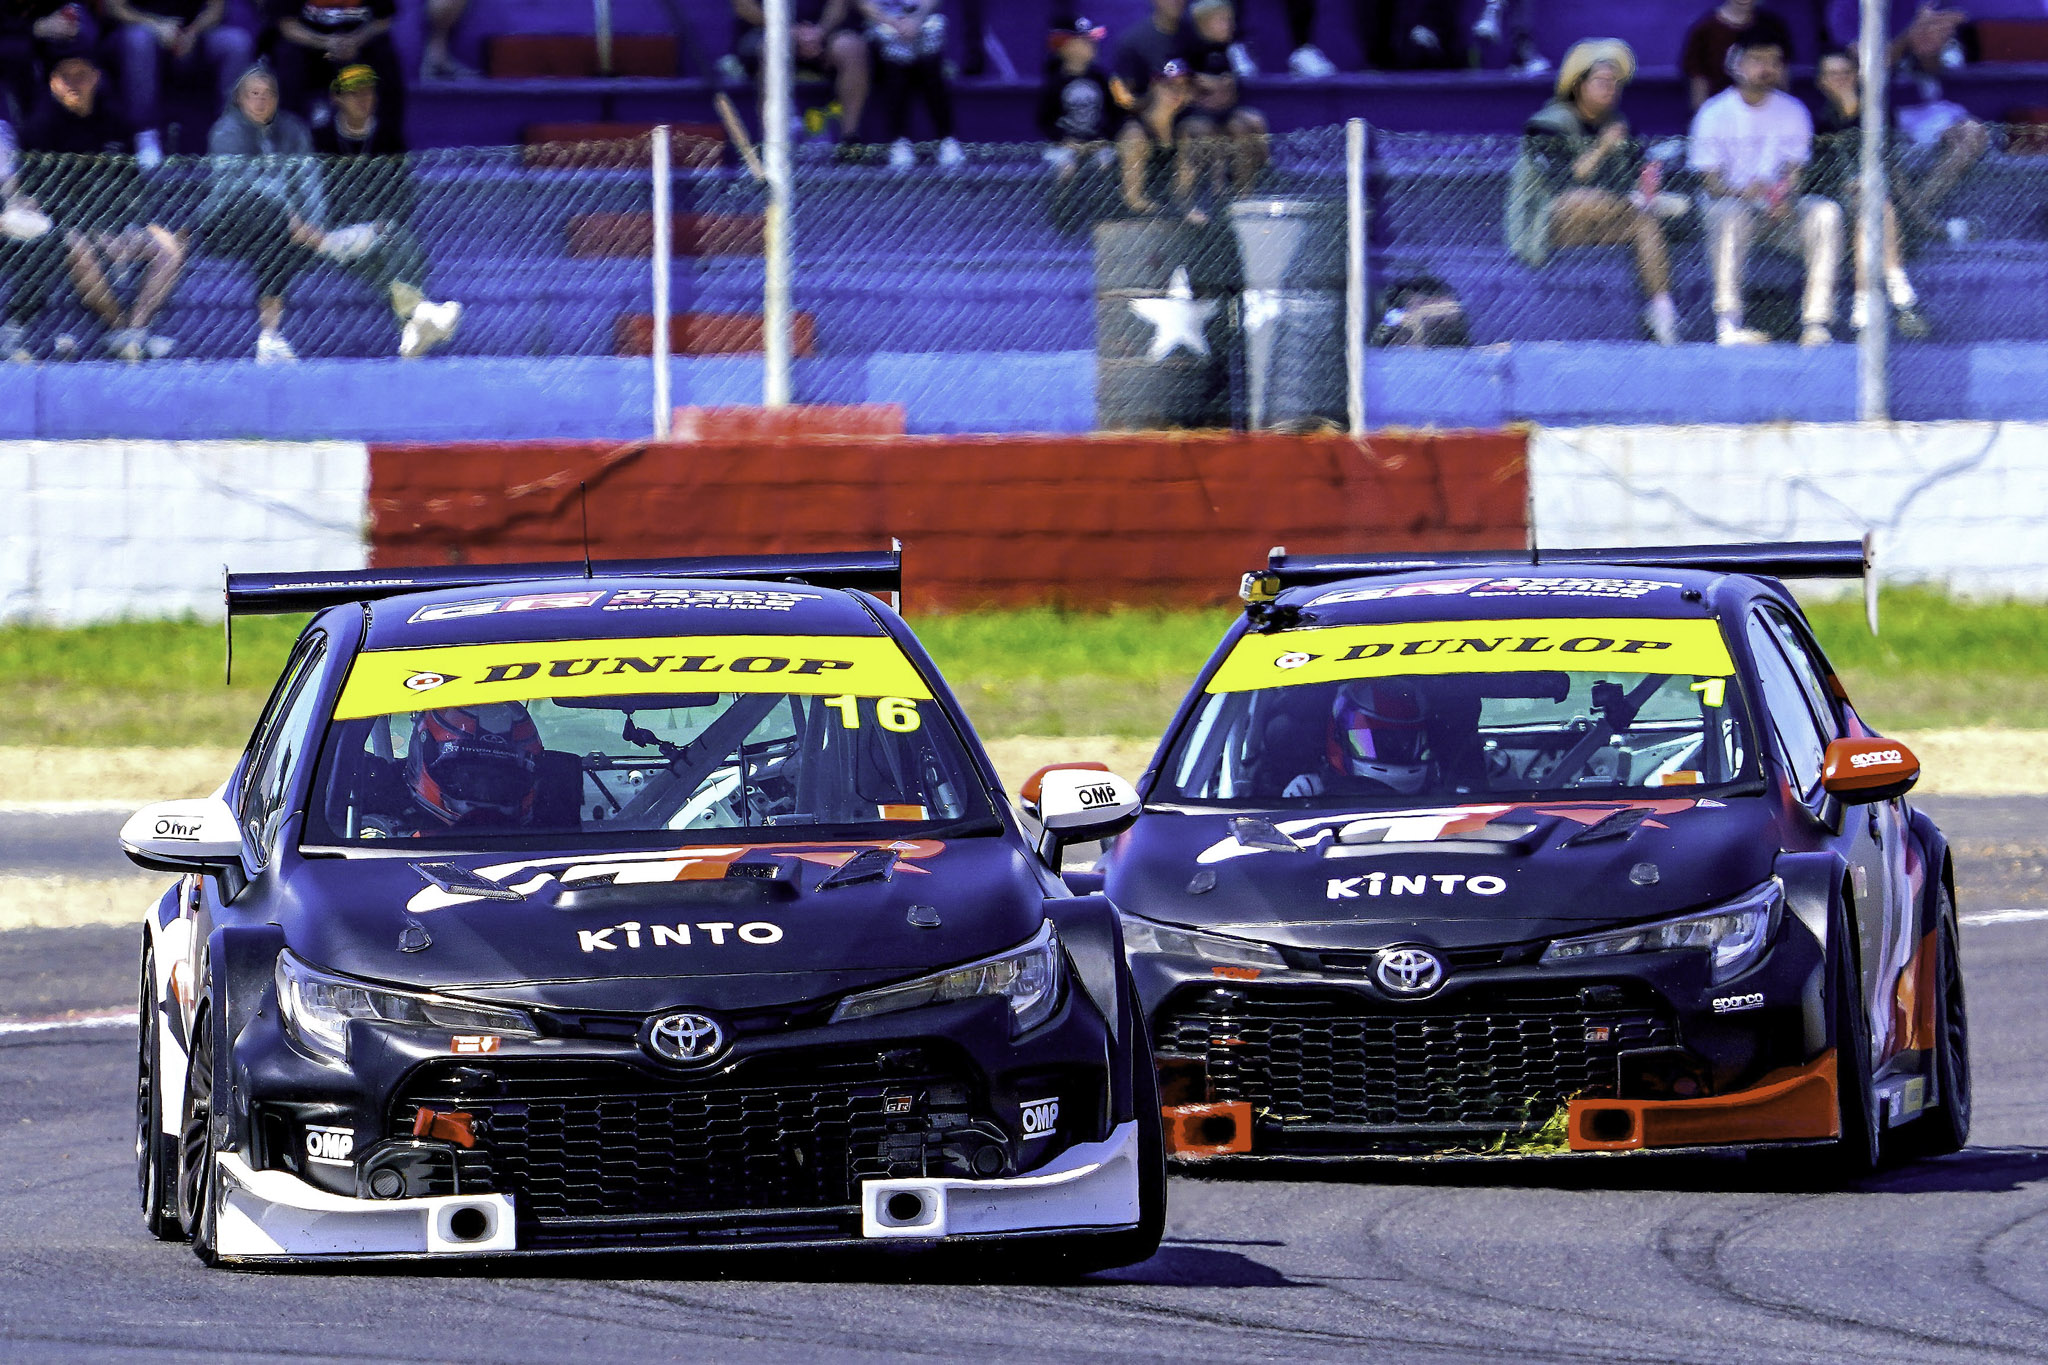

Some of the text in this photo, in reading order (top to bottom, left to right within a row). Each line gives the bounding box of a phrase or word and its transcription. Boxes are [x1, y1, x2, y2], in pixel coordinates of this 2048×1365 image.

[1335, 636, 1673, 662] DUNLOP
[474, 655, 855, 685] DUNLOP
[1690, 677, 1726, 708] 1
[824, 694, 921, 733] 16
[1078, 785, 1116, 805] OMP
[1712, 992, 1764, 1012] sparco
[1022, 1103, 1059, 1133] OMP
[306, 1131, 354, 1160] OMP
